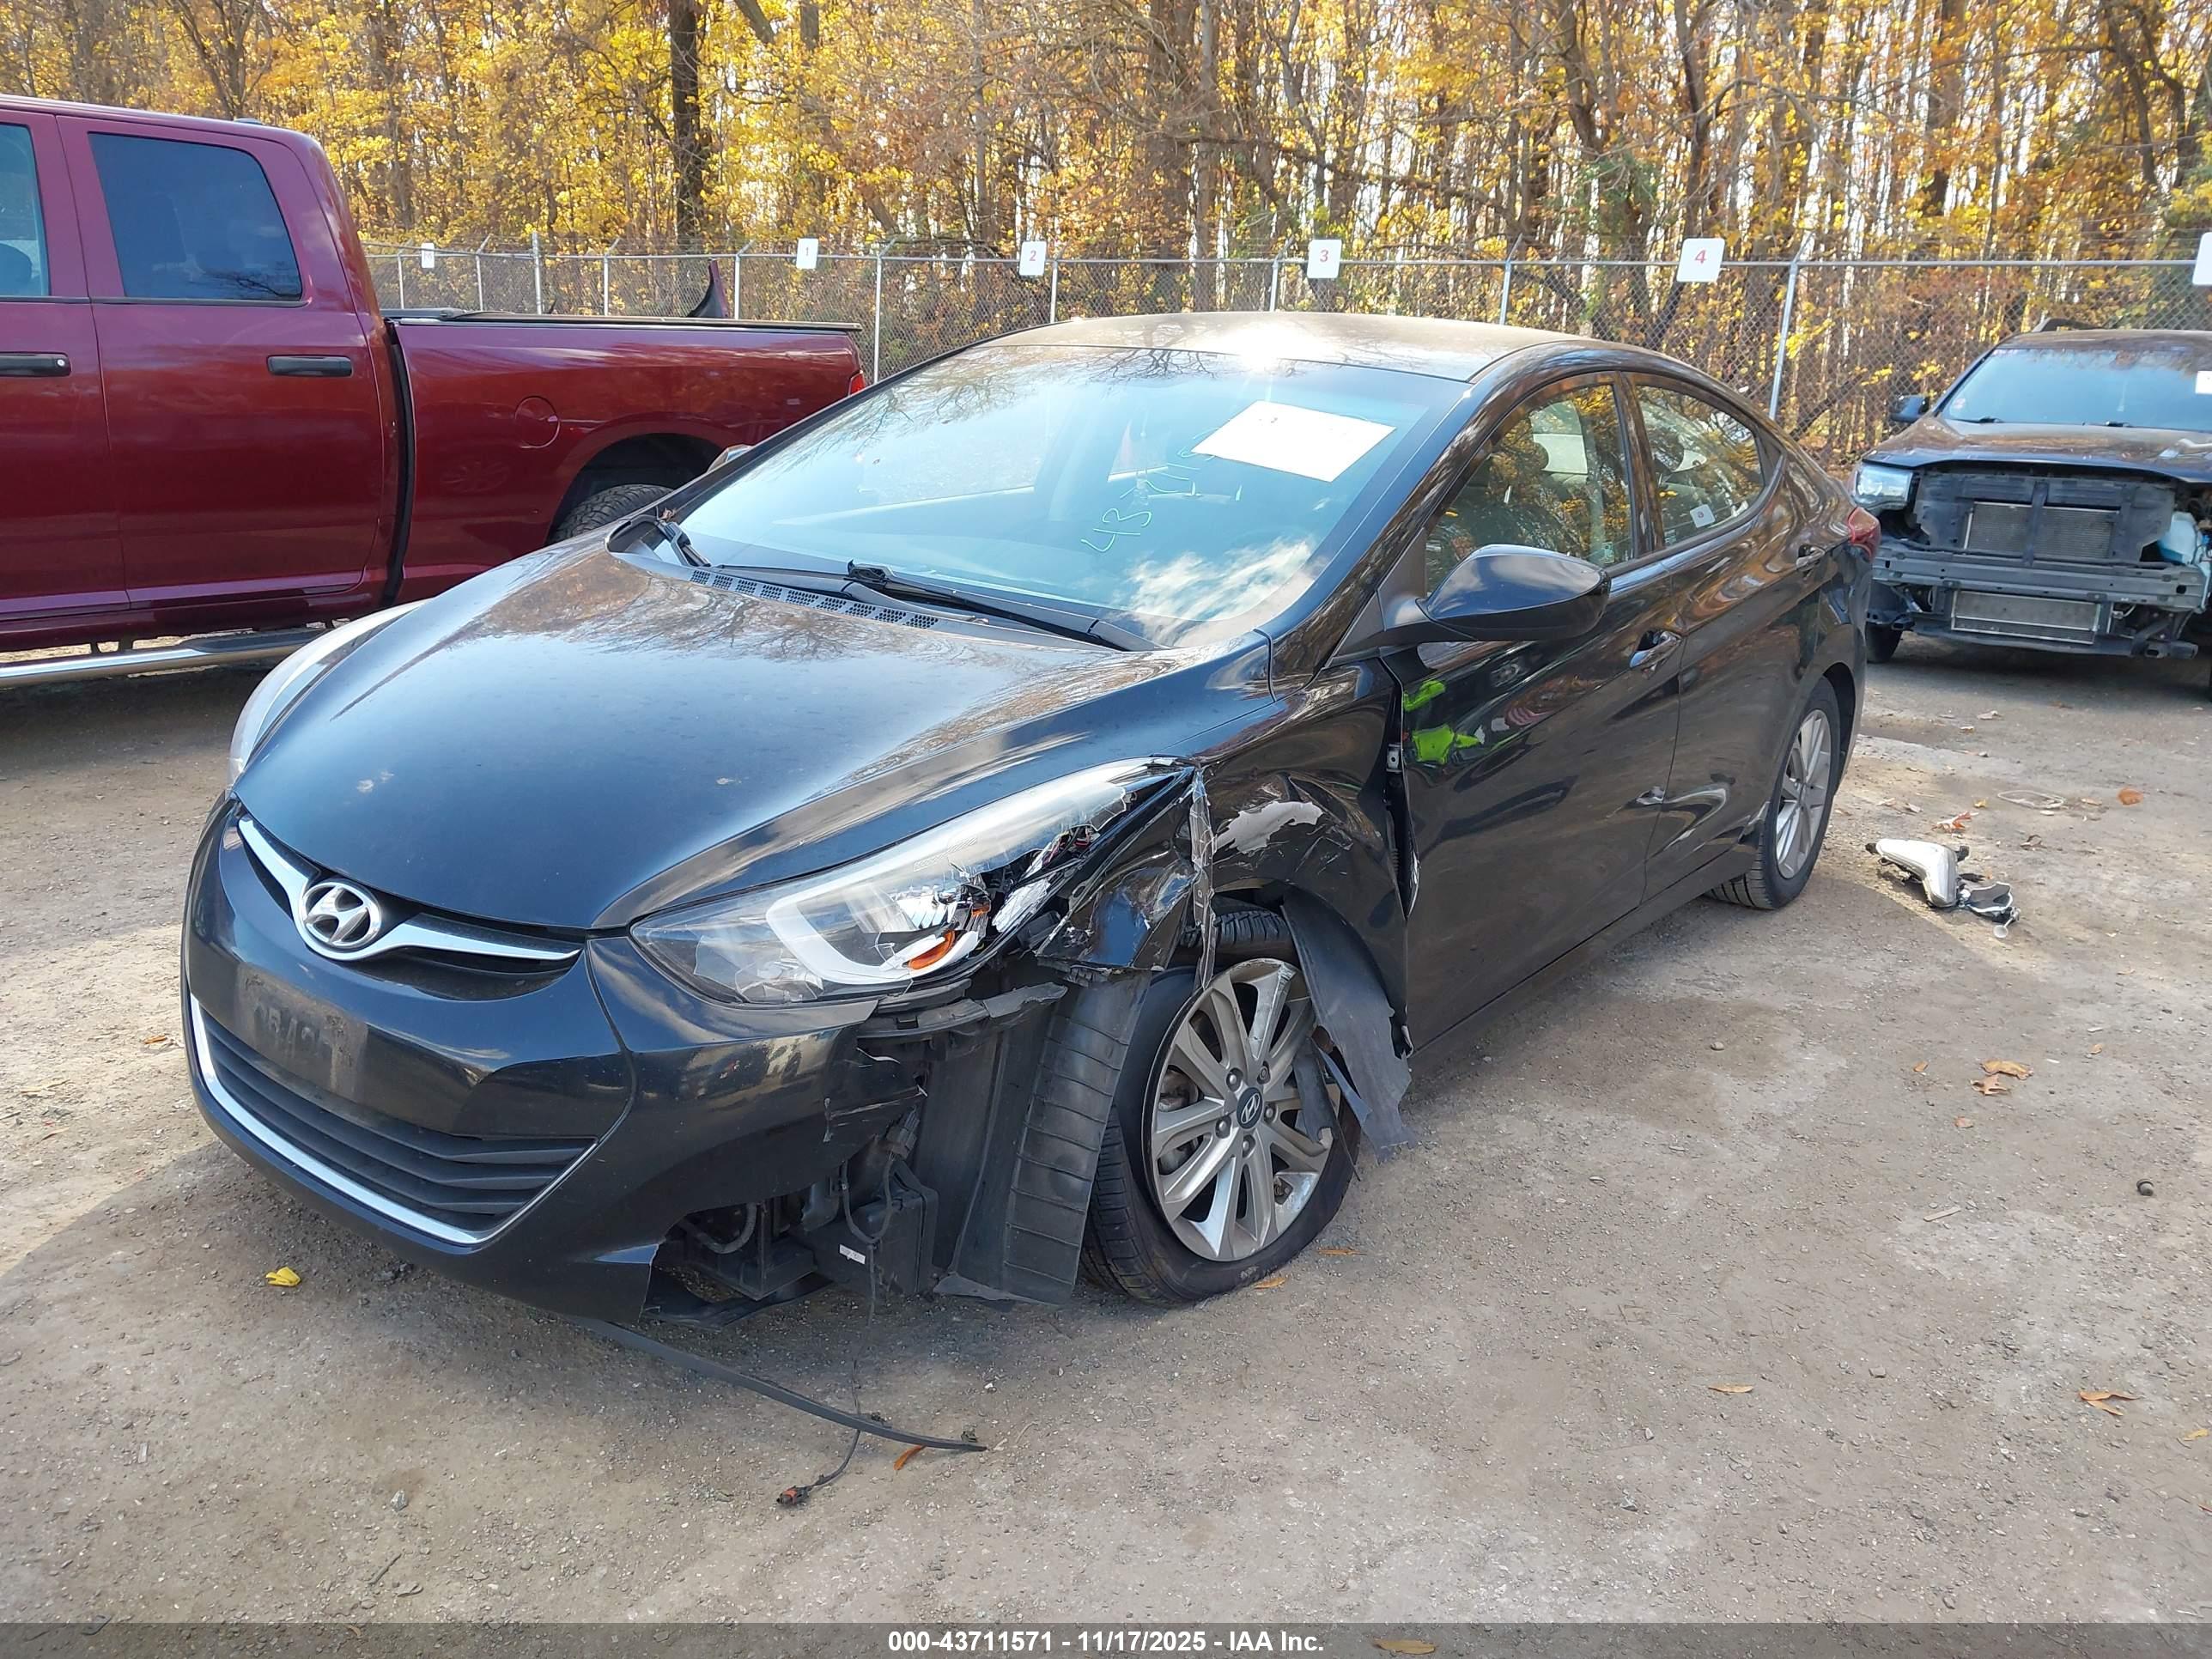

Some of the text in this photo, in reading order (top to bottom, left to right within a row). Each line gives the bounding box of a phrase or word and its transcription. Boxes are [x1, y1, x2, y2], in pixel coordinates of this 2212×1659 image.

[1029, 249, 1036, 262] 2
[1319, 248, 1329, 263] 3
[1694, 249, 1707, 264] 4
